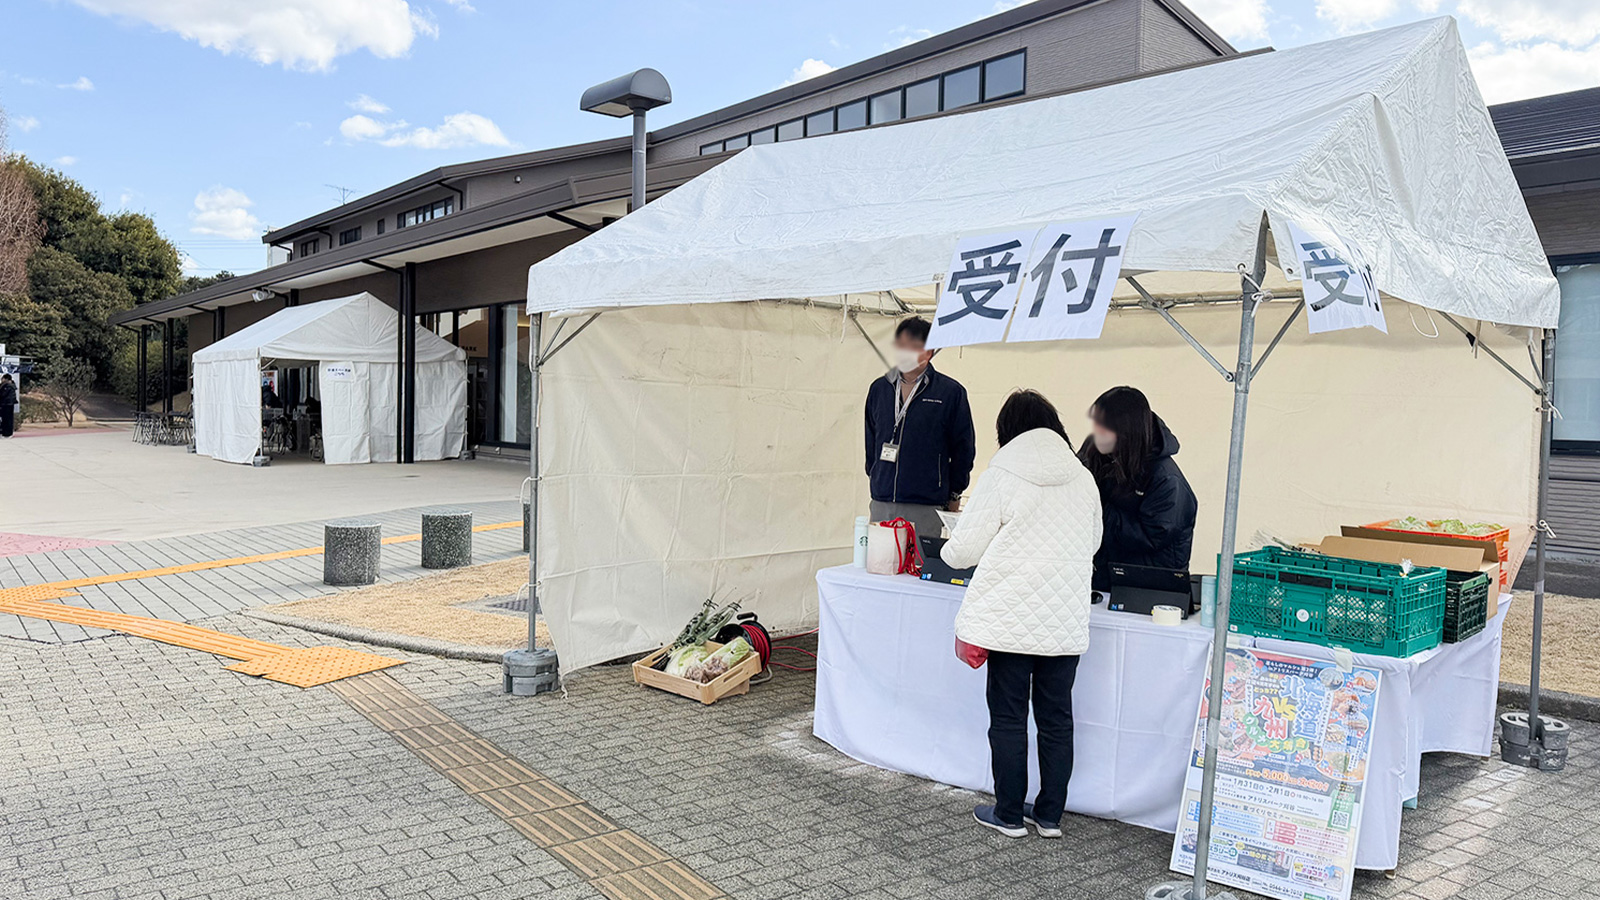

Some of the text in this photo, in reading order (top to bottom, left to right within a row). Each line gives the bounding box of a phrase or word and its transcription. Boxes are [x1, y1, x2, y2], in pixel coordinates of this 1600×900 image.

[938, 228, 1122, 326] 受付
[1253, 696, 1287, 739] 九州
[1272, 697, 1297, 721] VS
[1280, 675, 1324, 740] 北海道
